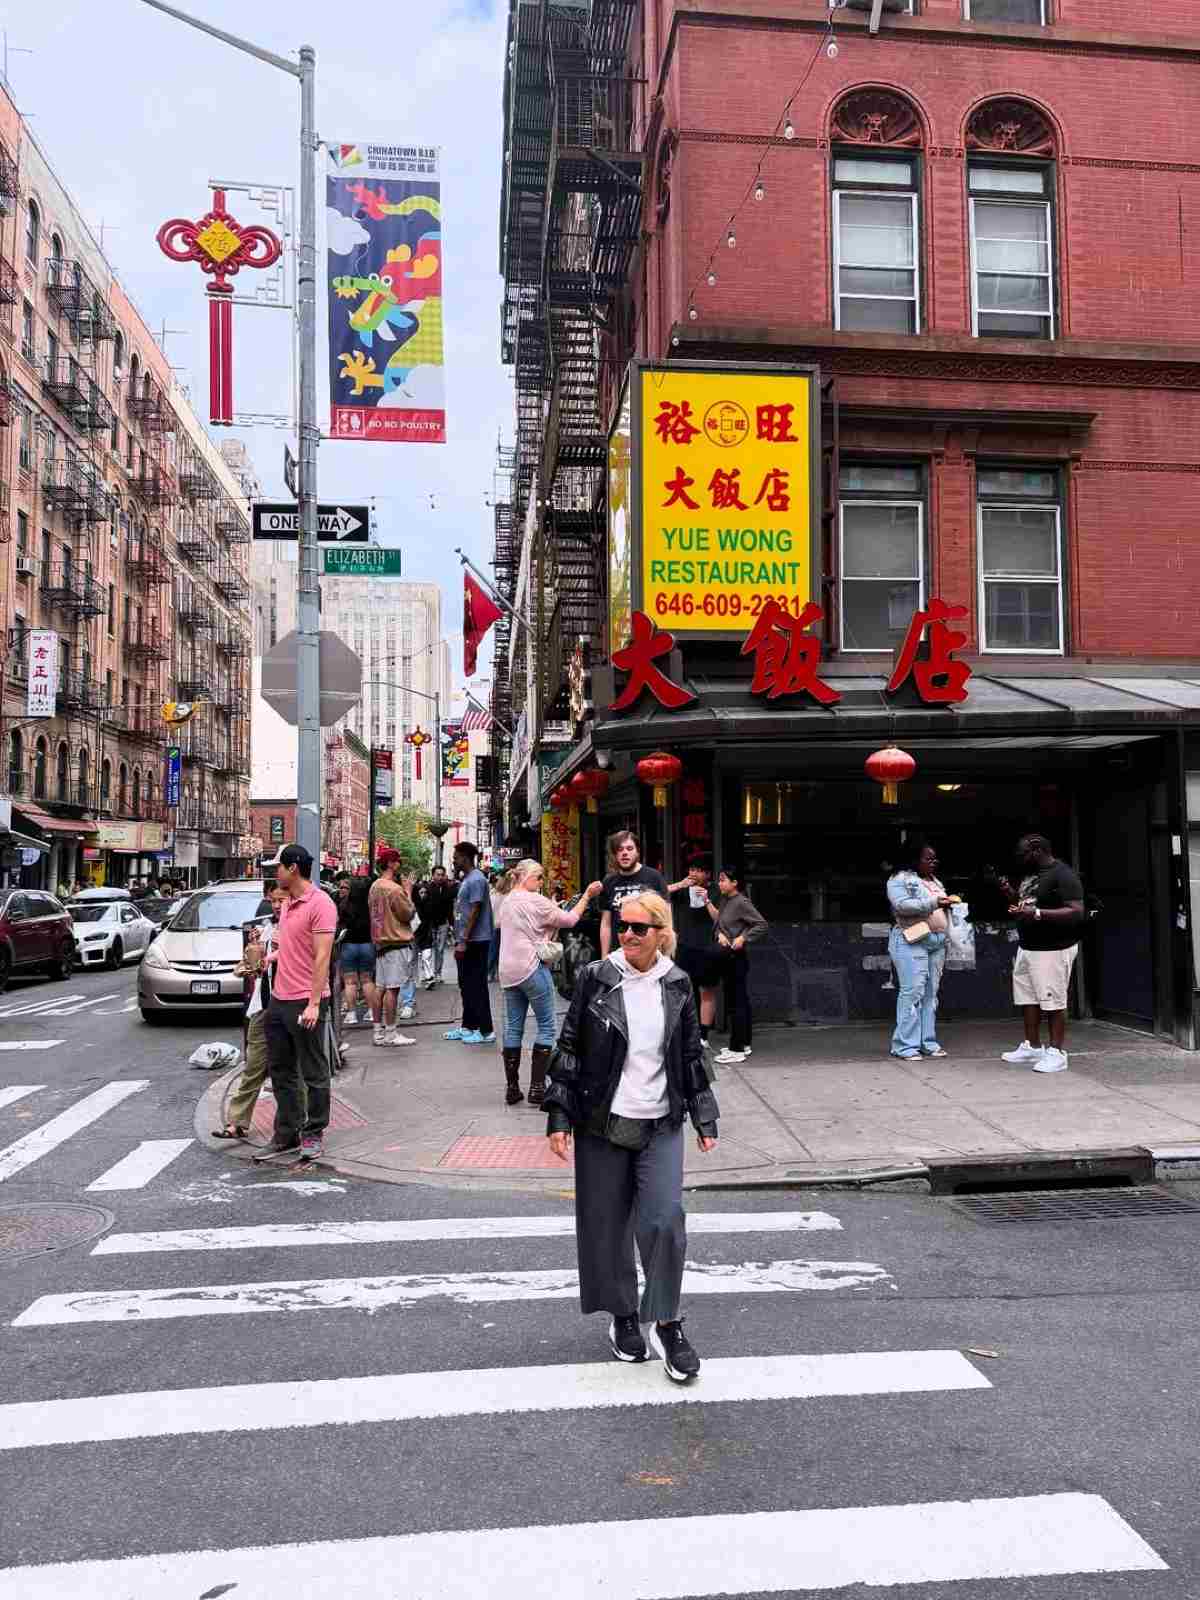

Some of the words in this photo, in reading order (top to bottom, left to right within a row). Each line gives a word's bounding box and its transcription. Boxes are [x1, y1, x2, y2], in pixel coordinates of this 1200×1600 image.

[367, 146, 416, 156] CHINATOWN
[400, 422, 441, 430] POULTRY
[654, 400, 701, 444] 裕
[755, 402, 799, 443] 旺
[661, 466, 791, 512] 大飯店
[270, 515, 299, 529] ONE
[318, 517, 351, 530] WAY
[661, 527, 710, 551] YUE
[718, 528, 793, 552] WONG
[327, 550, 385, 564] ELIZABETH
[651, 560, 800, 585] RESTAURANT
[607, 598, 971, 711] 大飯店
